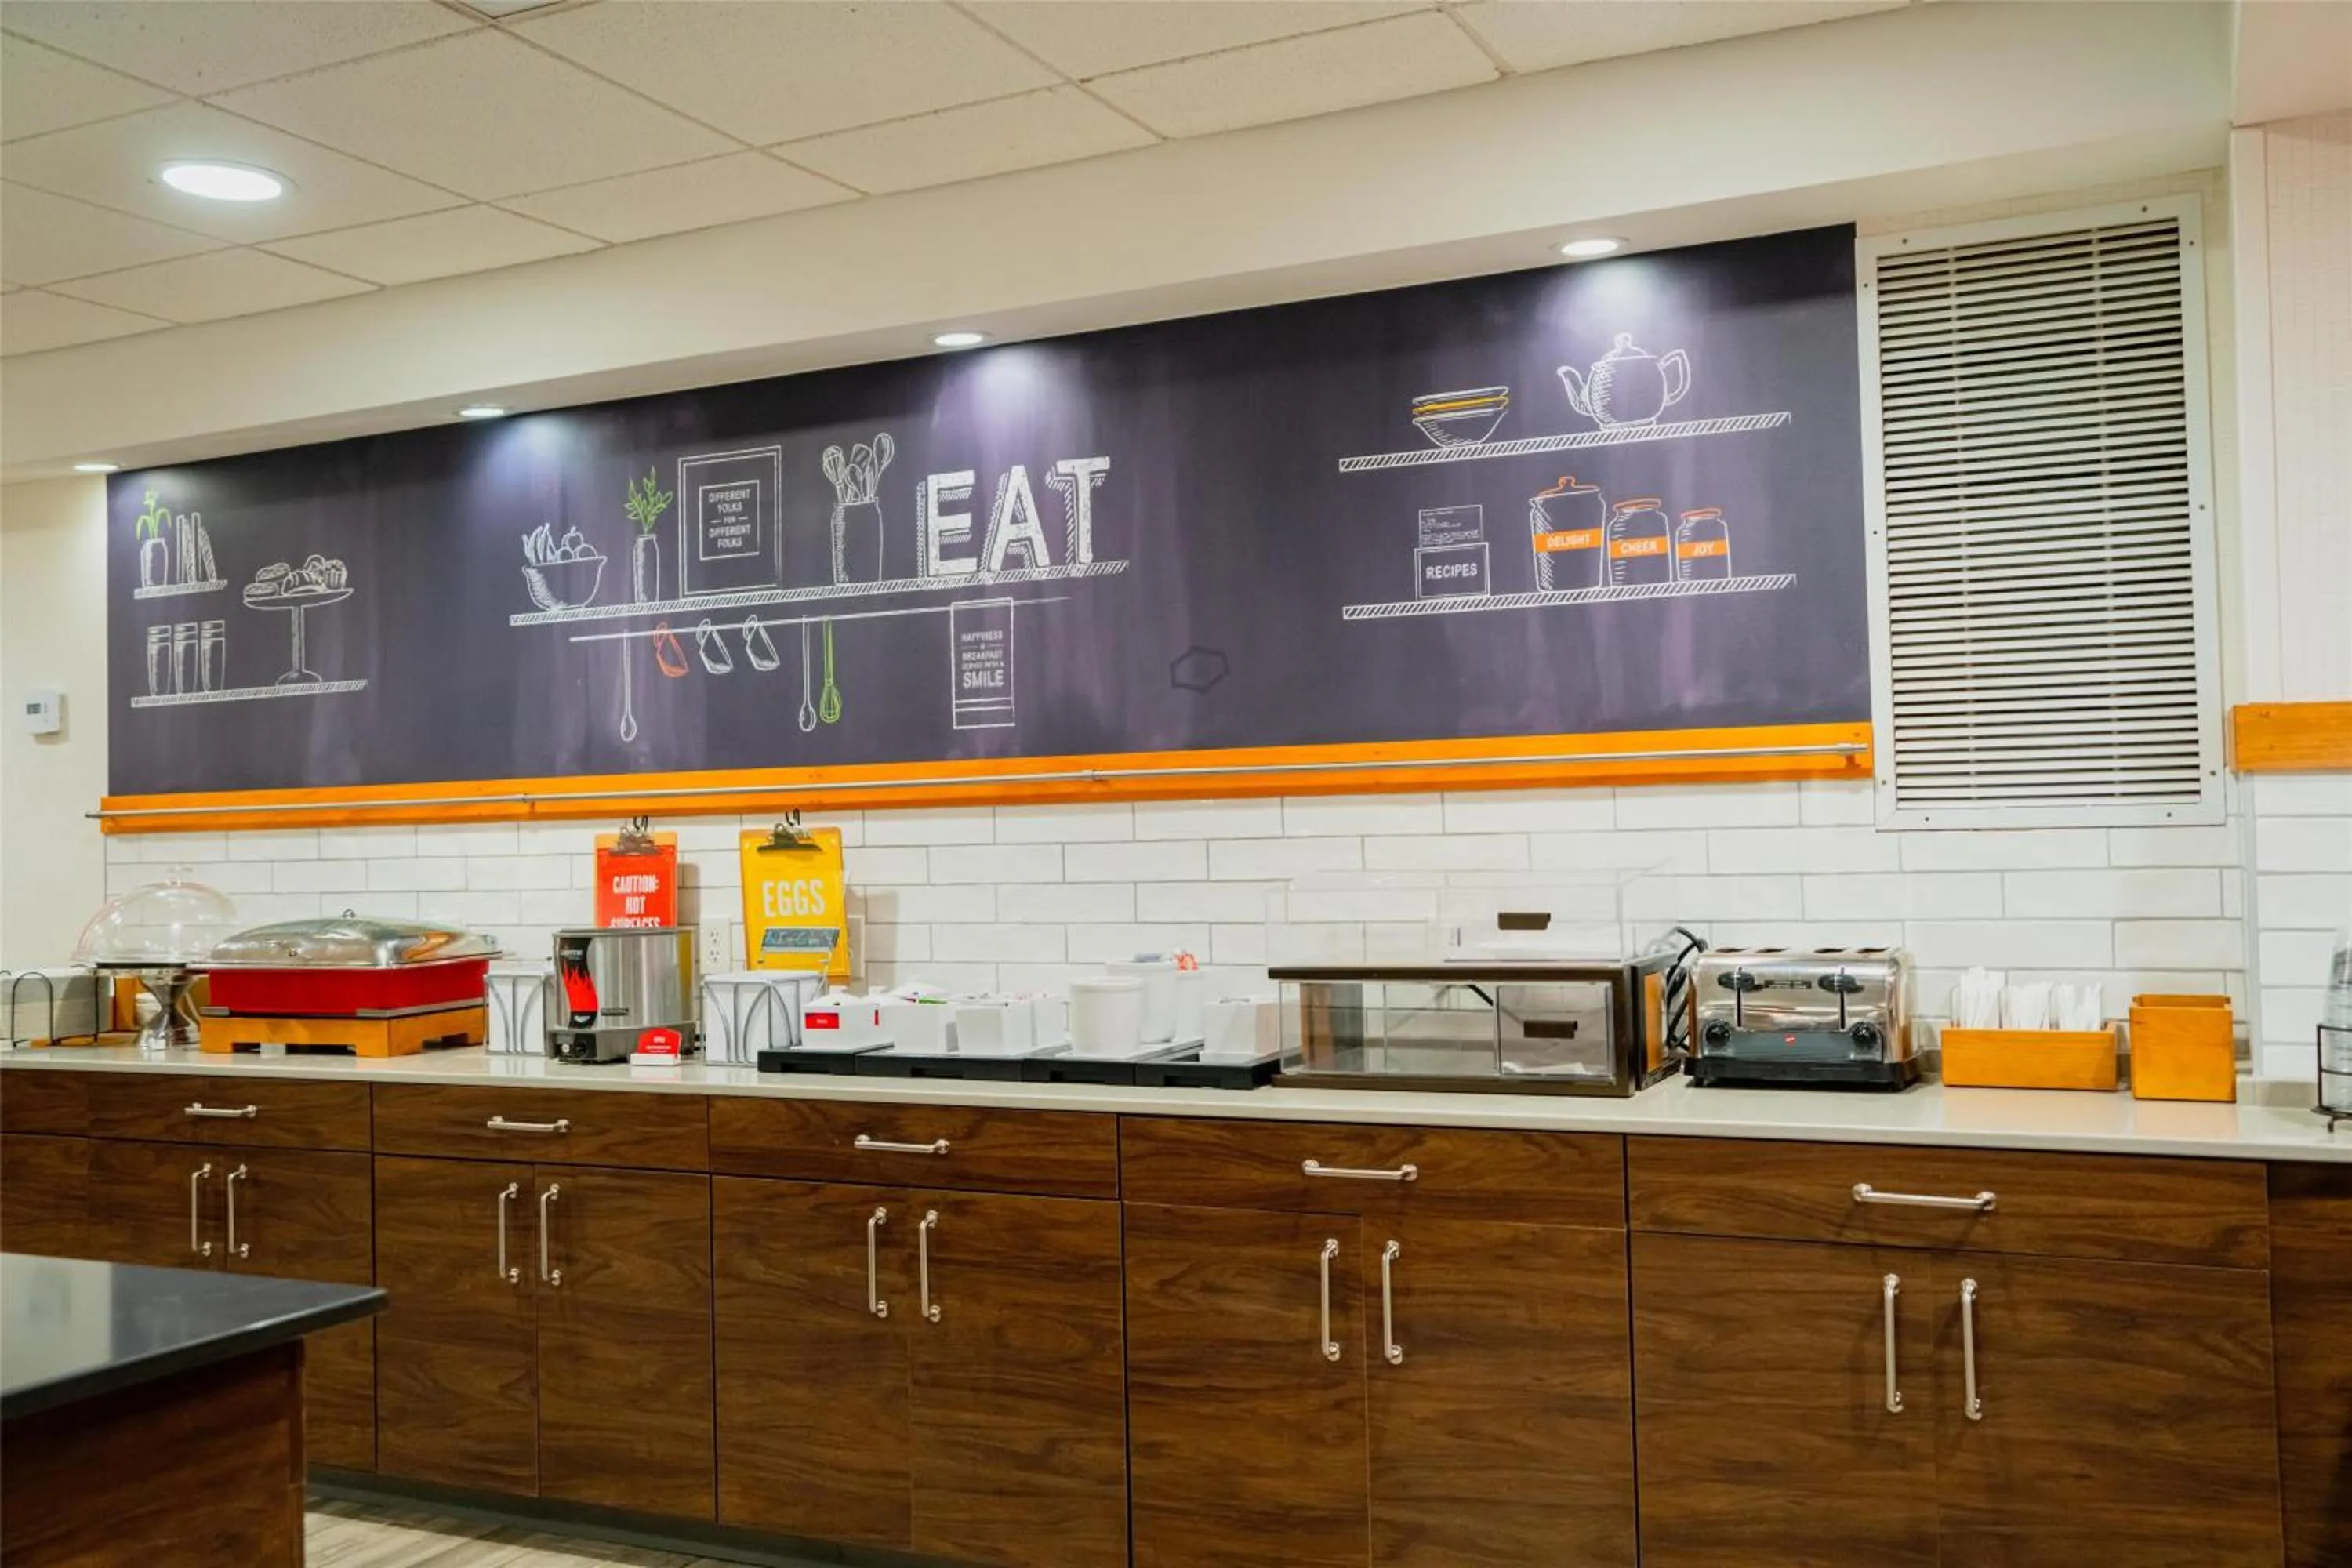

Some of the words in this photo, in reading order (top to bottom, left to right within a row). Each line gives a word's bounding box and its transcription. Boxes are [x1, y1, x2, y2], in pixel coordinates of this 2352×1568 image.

[709, 489, 750, 503] DIFFERENT
[717, 502, 742, 514] YOLKS
[917, 456, 1110, 578] EAT
[709, 524, 750, 538] DIFFERENT
[717, 538, 742, 549] FOLKS
[1546, 533, 1592, 549] DELIGHT
[1620, 539, 1657, 554] CHEER
[1693, 543, 1715, 556] JOY
[1425, 563, 1477, 579] RECIPES
[961, 630, 1003, 641] HAPPINESS
[962, 651, 1003, 660] BREAKFAST
[963, 670, 1004, 688] SMILE
[762, 878, 826, 918] EGGS
[625, 896, 646, 915] HOT
